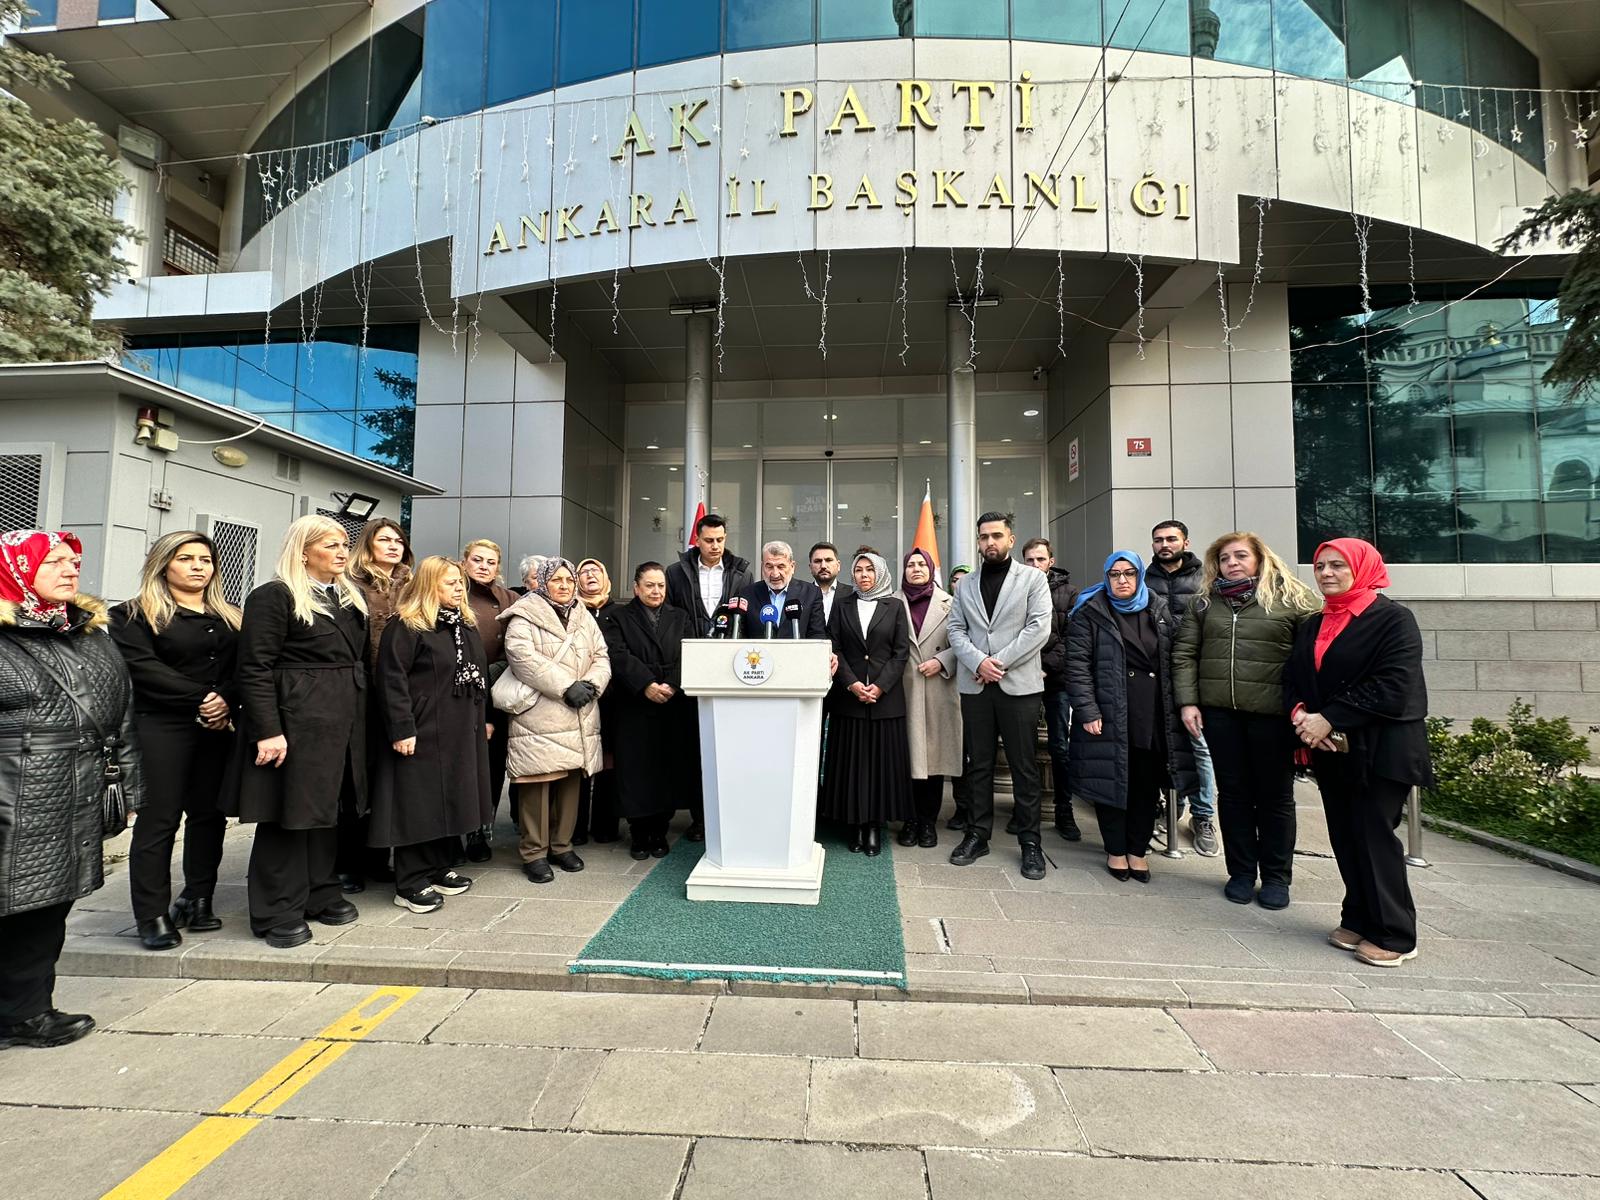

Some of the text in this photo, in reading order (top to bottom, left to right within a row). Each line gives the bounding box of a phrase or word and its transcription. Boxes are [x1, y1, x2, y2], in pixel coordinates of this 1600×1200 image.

[610, 70, 1035, 160] AK PARTİ
[483, 190, 698, 256] ANKARA
[726, 172, 778, 217] İL
[1133, 440, 1145, 450] 75
